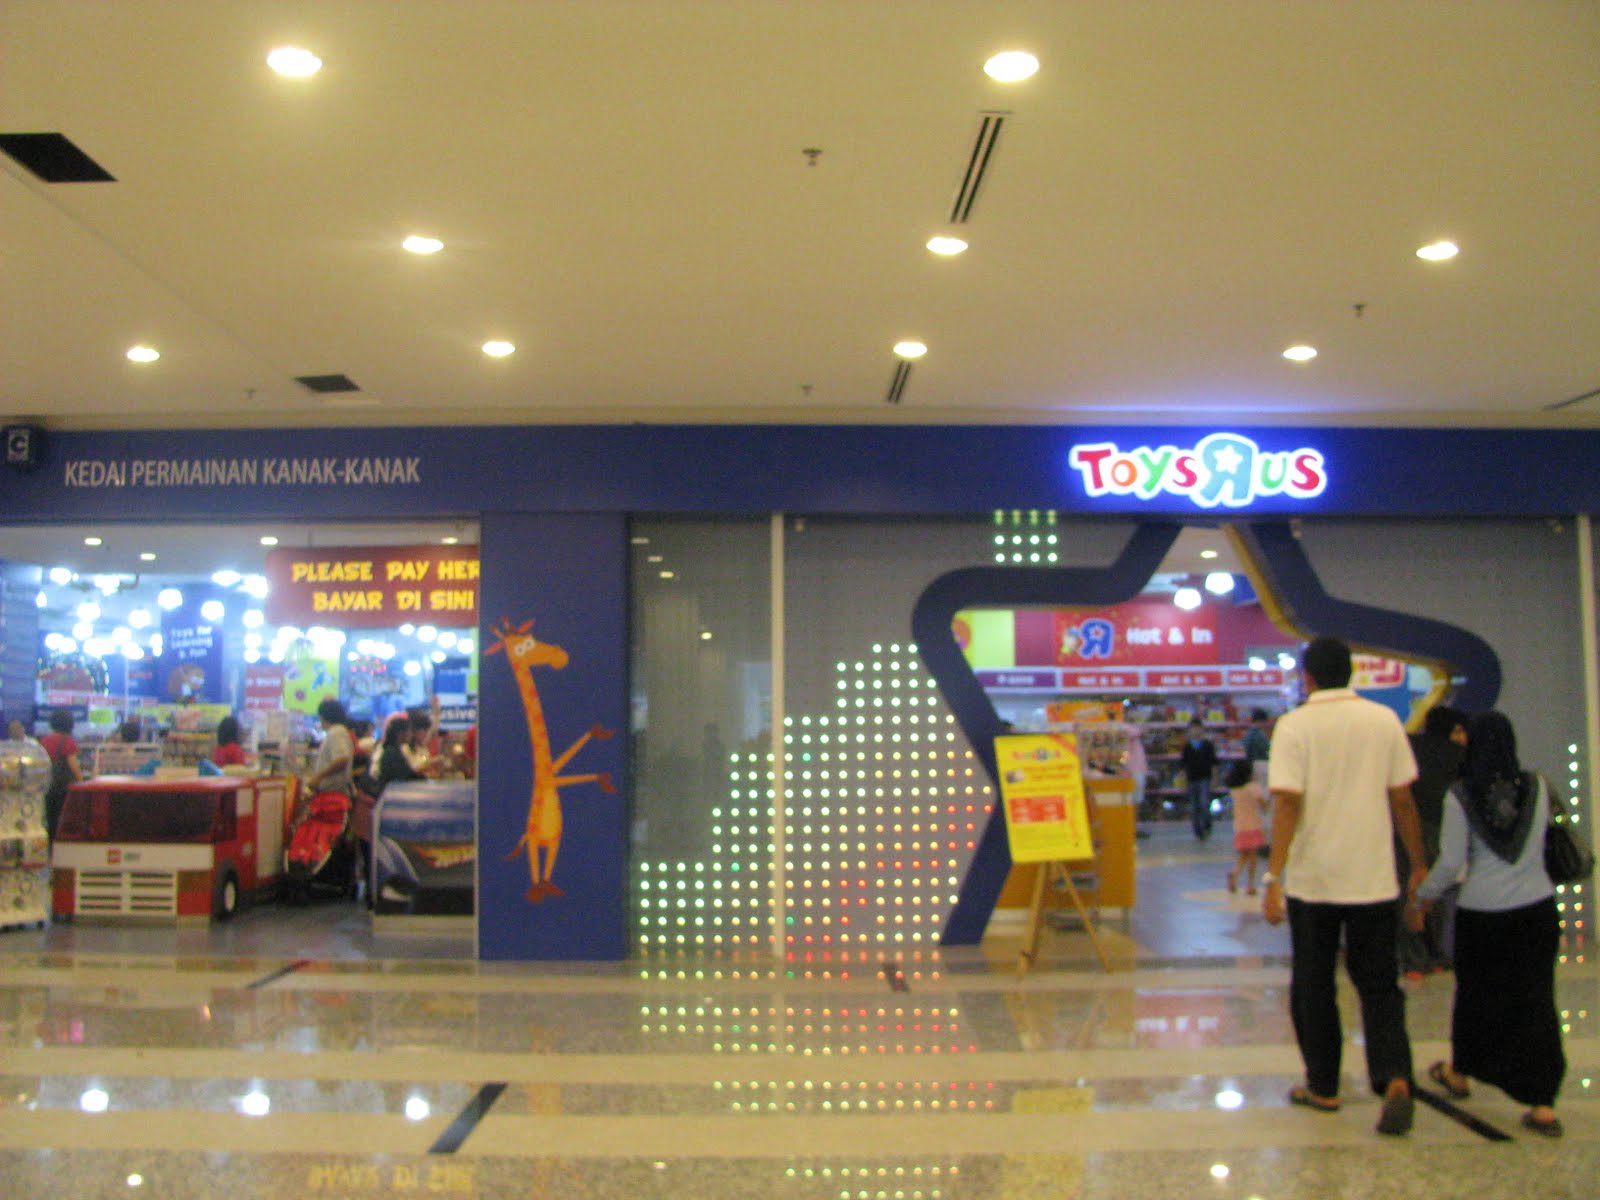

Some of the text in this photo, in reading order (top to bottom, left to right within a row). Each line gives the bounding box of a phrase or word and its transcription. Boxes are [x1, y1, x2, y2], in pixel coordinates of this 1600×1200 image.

[65, 457, 421, 487] KEDAI PERMAINAN KANAK-KANAK
[292, 561, 373, 582] PLEASE
[386, 560, 430, 581] PAY
[313, 590, 475, 612] BAYAR DI SINI
[1126, 626, 1213, 645] Hot & In
